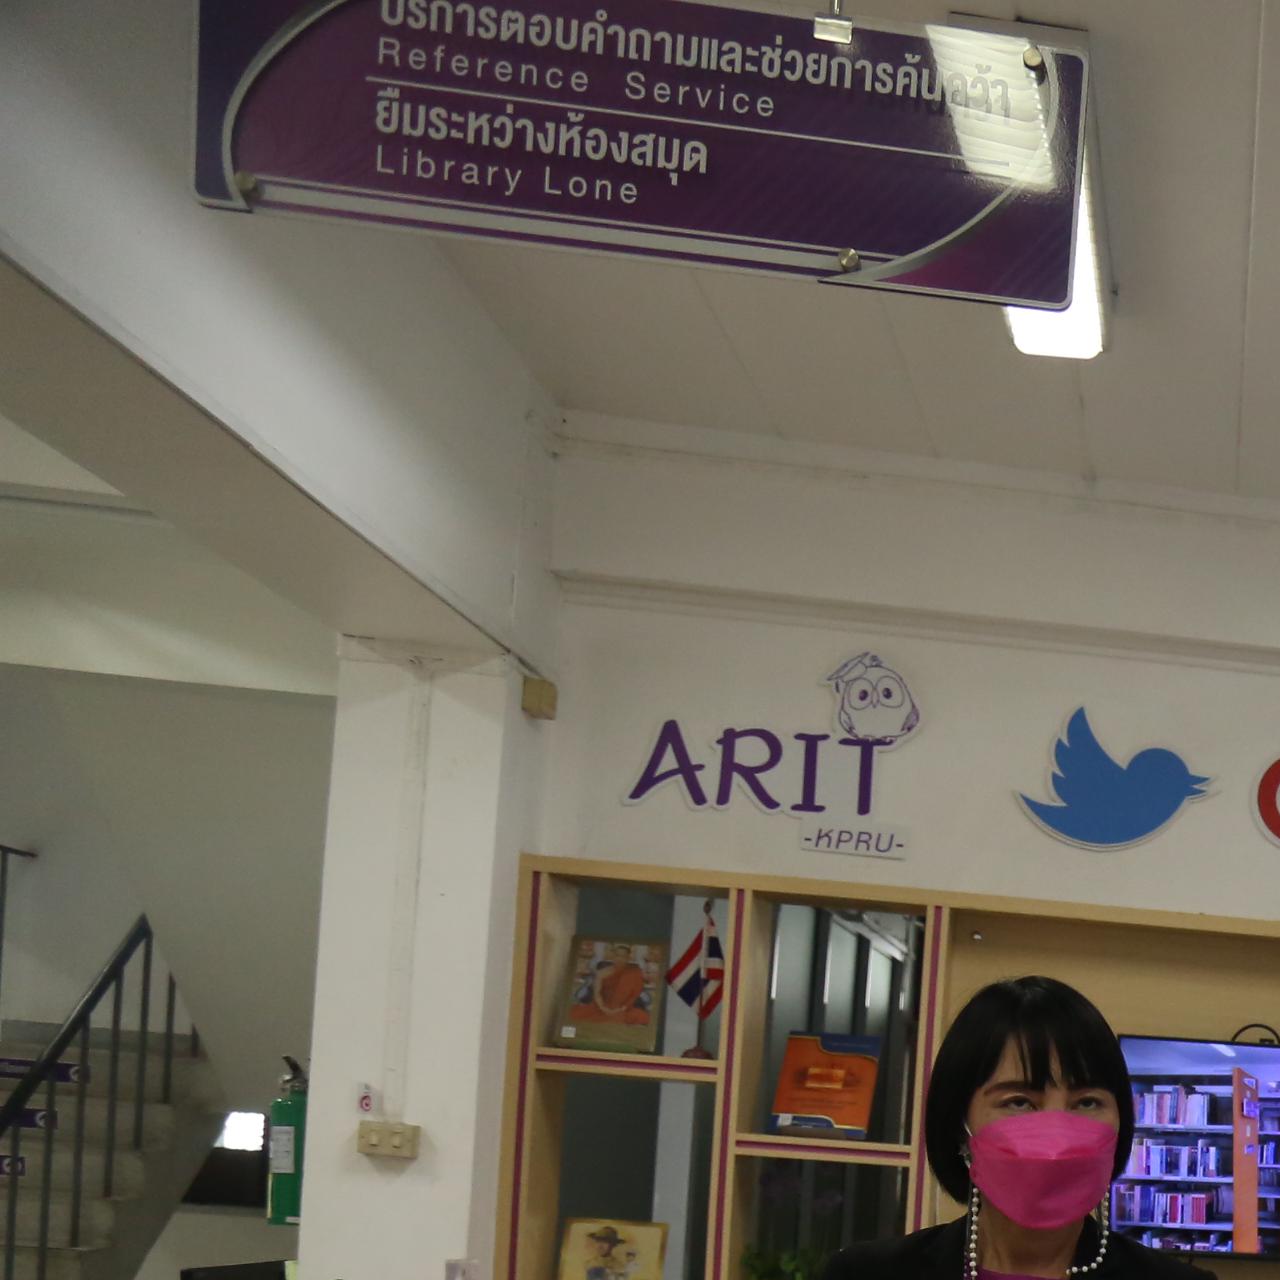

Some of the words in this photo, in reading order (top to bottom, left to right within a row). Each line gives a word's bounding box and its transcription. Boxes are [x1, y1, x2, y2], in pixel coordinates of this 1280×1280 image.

[377, 36, 590, 93] Reference
[624, 71, 775, 118] Service
[380, 0, 1011, 117] บรการตอบคำถามและช่วยการค้นคว้า
[375, 86, 708, 187] ยืมระหว่างห้องสมุด
[375, 144, 523, 196] Library
[544, 166, 639, 204] Lone
[628, 719, 896, 815] ARIT
